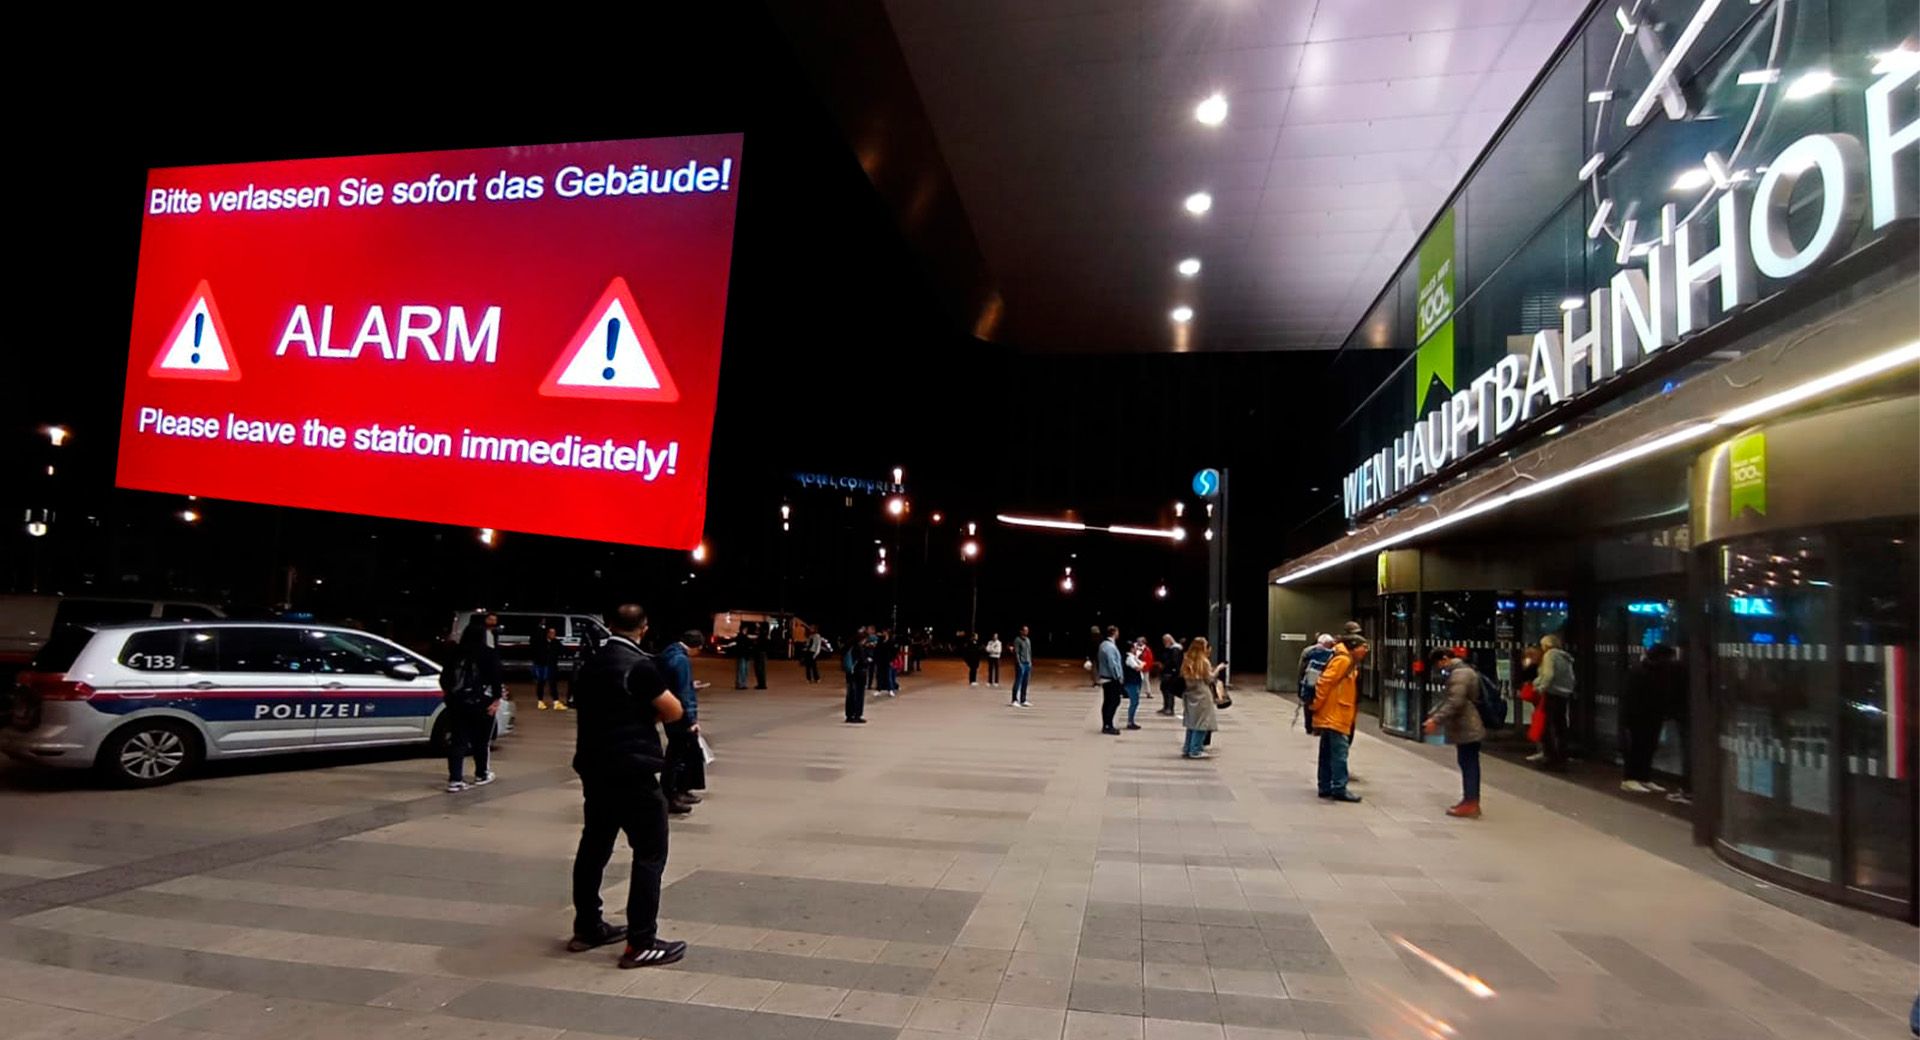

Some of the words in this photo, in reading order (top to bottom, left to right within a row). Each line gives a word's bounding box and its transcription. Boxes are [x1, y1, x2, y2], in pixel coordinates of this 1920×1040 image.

[149, 188, 202, 214] Bitte
[209, 184, 330, 211] verlassen
[338, 178, 384, 206] Sie
[392, 174, 477, 205] sofort
[485, 170, 544, 200] das
[555, 158, 732, 198] Gebäude!
[276, 304, 502, 363] ALARM
[138, 406, 220, 438] Please
[226, 413, 296, 444] leave
[303, 418, 346, 448] the
[354, 424, 452, 456] station
[461, 428, 679, 481] immediately!
[1343, 447, 1393, 519] WIEN
[144, 654, 175, 669] 133
[254, 703, 361, 719] POLIZEI
